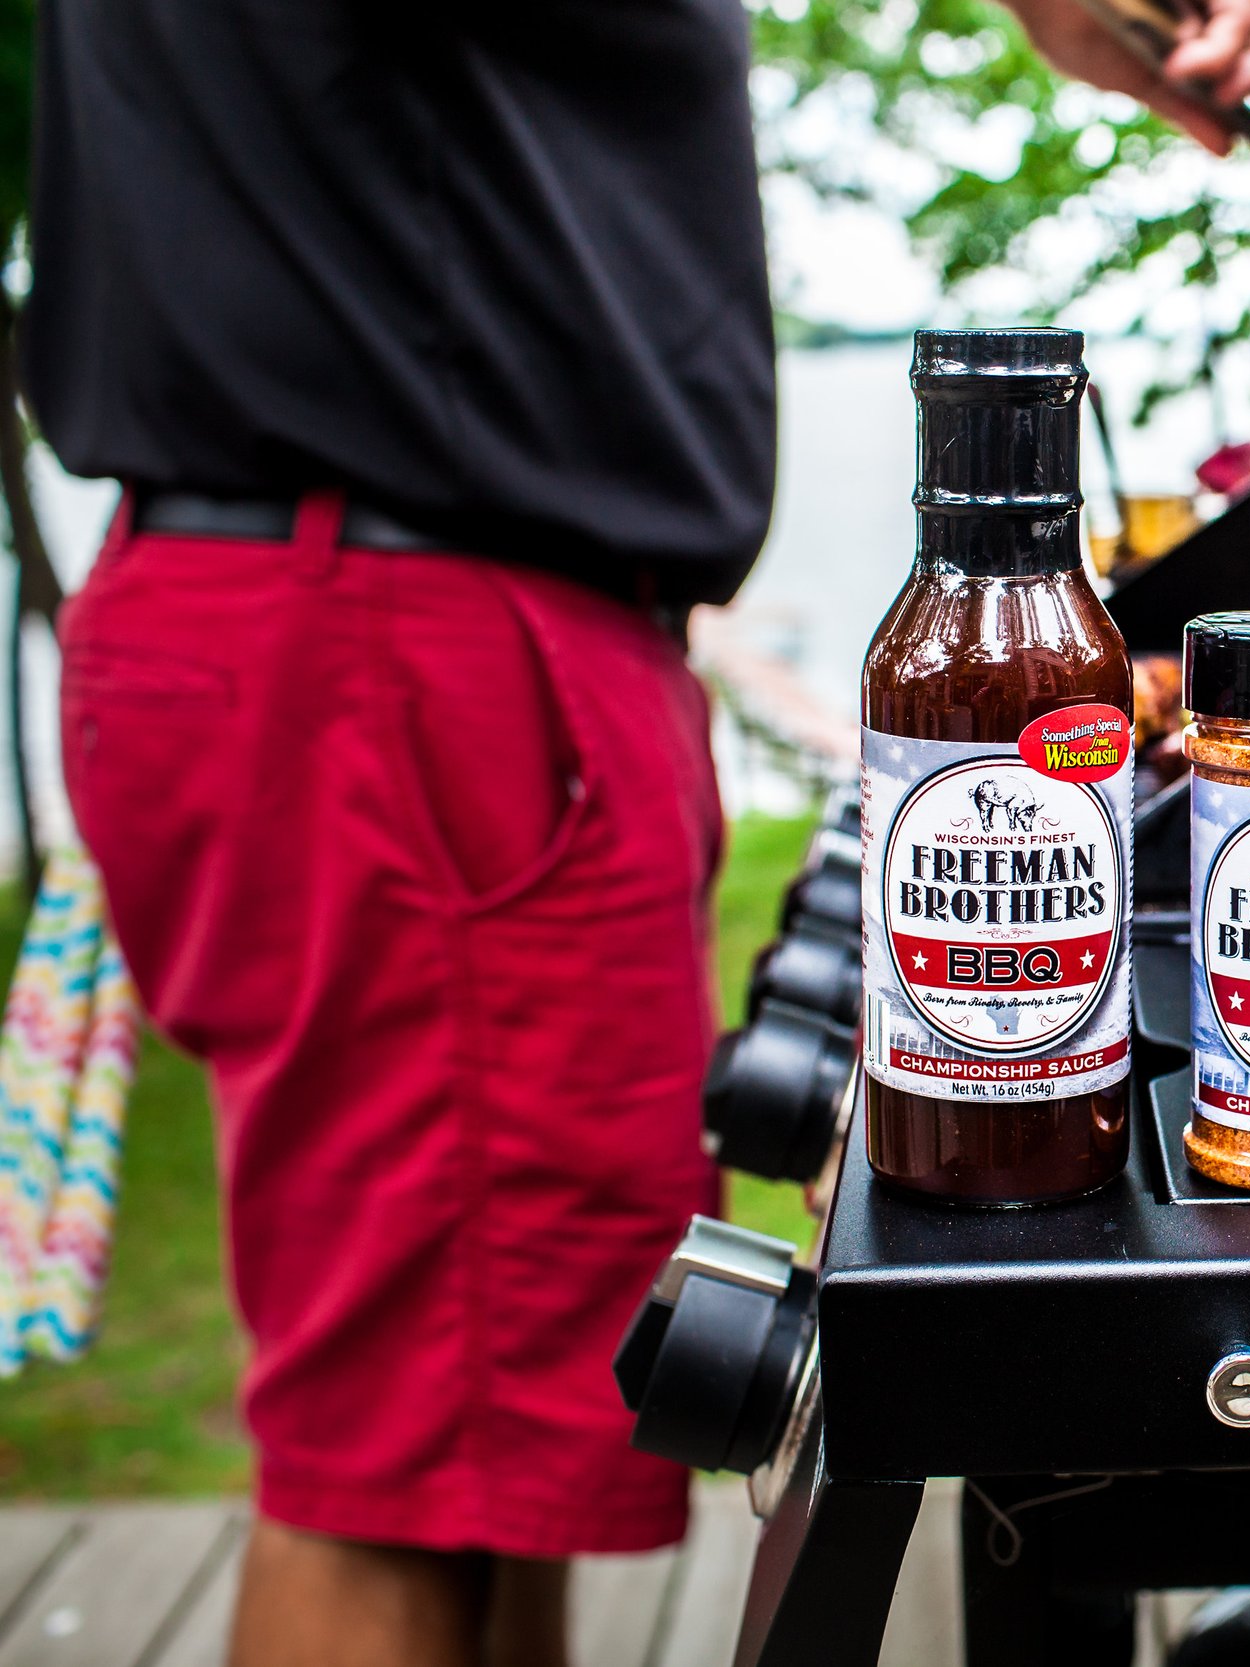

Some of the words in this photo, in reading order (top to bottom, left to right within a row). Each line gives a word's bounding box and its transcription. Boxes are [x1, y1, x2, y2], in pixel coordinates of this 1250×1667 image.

[1041, 723, 1096, 742] Something
[1096, 718, 1122, 735] Special
[1089, 736, 1110, 750] from
[1043, 743, 1118, 770] Wisconsin
[934, 832, 1024, 845] WISCONSIN'S
[1030, 832, 1076, 845] FINEST
[911, 843, 1097, 886] FREEMAN
[900, 881, 1106, 925] BROTHERS
[946, 945, 1063, 985] BBQ
[922, 992, 945, 1004] Born
[945, 996, 967, 1007] from
[1045, 996, 1055, 1006] &
[1055, 992, 1084, 1004] Family
[900, 1055, 1042, 1079] CHAMPIONSHIP
[1048, 1052, 1104, 1075] SAUCE
[952, 1082, 970, 1095] Net
[971, 1083, 989, 1096] Wt.
[991, 1083, 1005, 1096] 16
[1007, 1086, 1020, 1096] oz
[1020, 1081, 1055, 1097] (454g)
